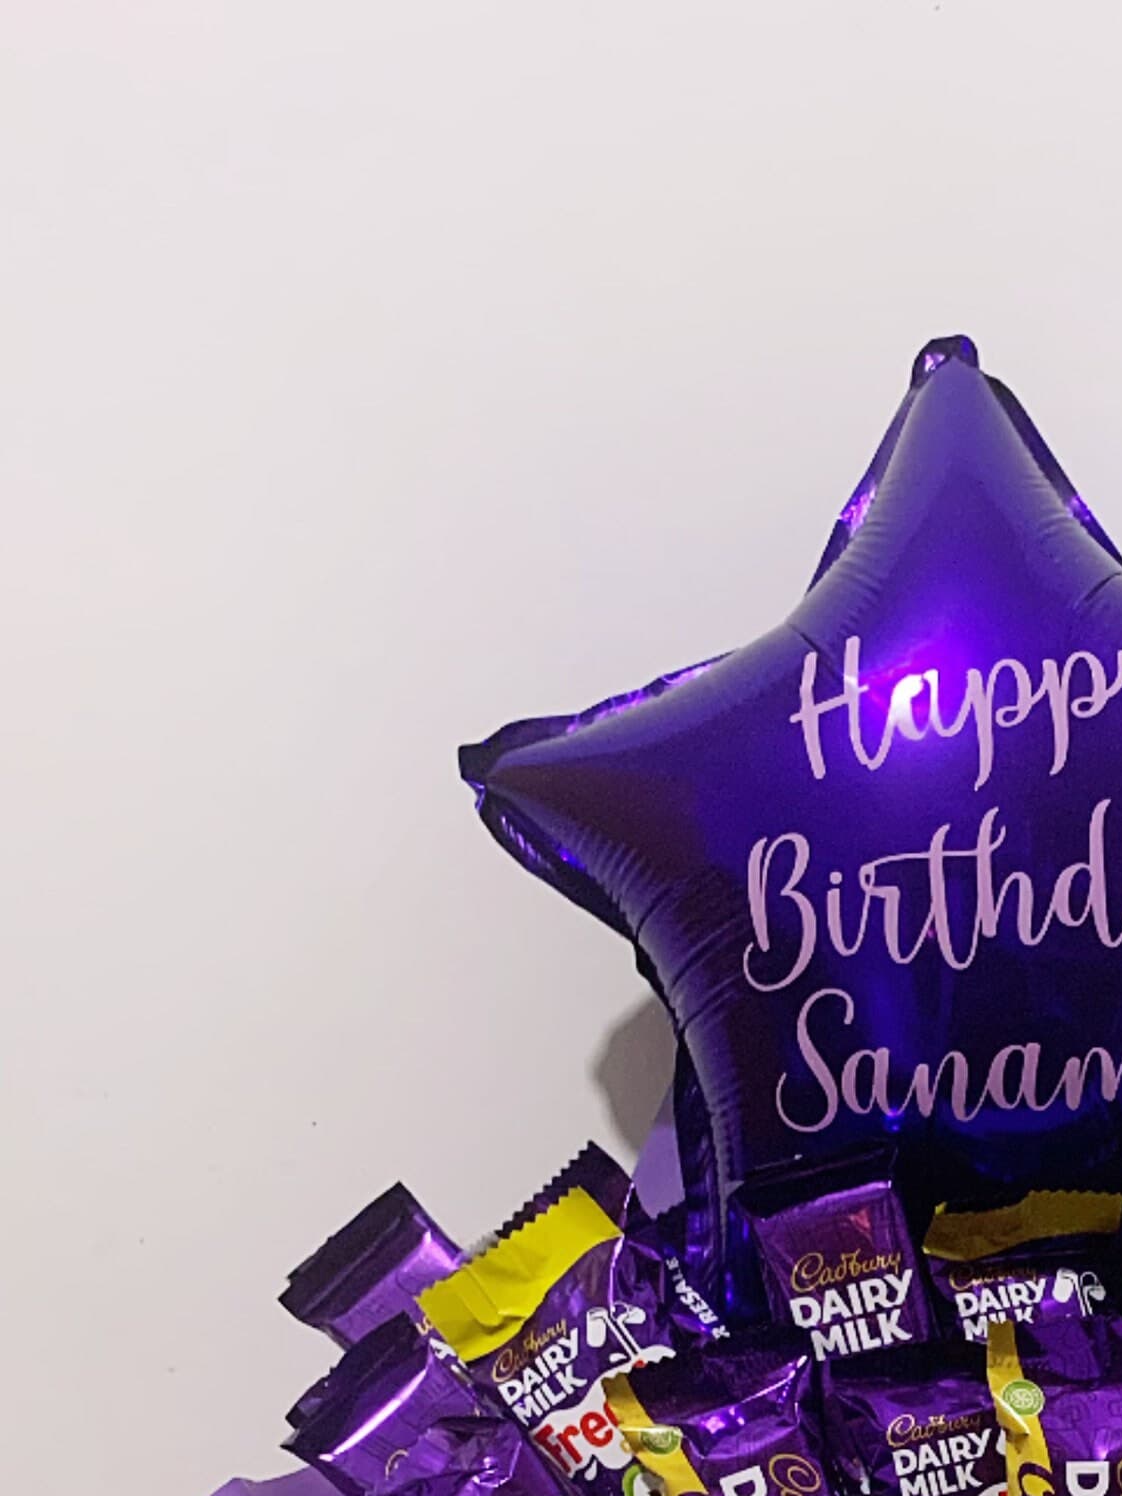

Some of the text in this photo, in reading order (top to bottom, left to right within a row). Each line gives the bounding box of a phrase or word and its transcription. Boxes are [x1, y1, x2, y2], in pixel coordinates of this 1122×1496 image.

[790, 1247, 902, 1293] Cadbury
[954, 1277, 1048, 1318] DAIRY
[788, 1268, 914, 1329] DAIRY
[492, 1317, 569, 1383] Cadbury
[810, 1307, 914, 1362] MILK
[498, 1332, 582, 1406] DAIRY
[512, 1371, 588, 1427] MILK
[886, 1413, 984, 1447] Cadbury
[892, 1428, 992, 1477] DAIRY
